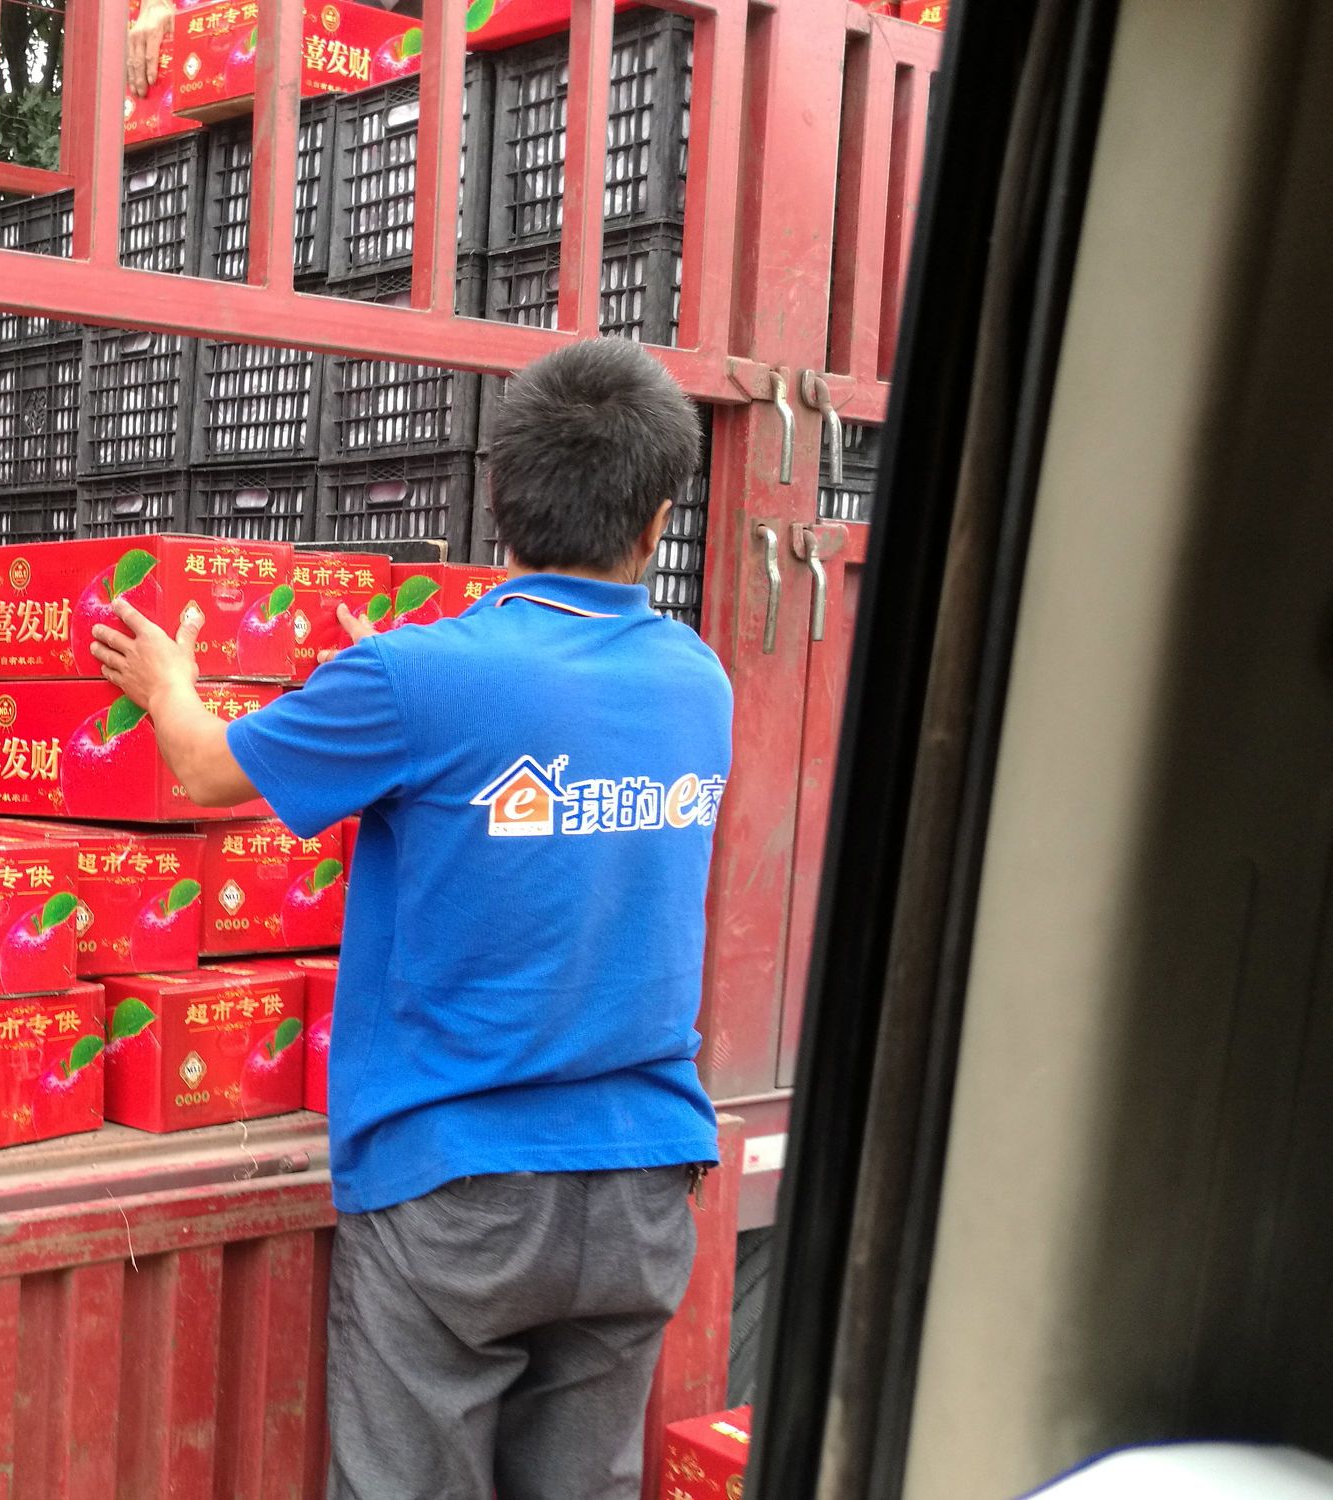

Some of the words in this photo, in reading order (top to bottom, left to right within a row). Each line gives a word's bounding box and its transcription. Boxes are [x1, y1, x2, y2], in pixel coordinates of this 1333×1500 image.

[188, 3, 258, 33] 超市专供
[303, 35, 371, 81] 喜发财
[184, 553, 277, 579] 超市专供
[293, 566, 375, 588] 超市专供
[203, 698, 261, 720] 市专供
[561, 773, 727, 835] 我的e家
[222, 833, 322, 856] 超市专供
[77, 852, 180, 874] 超市专供
[184, 993, 284, 1025] 超市专供
